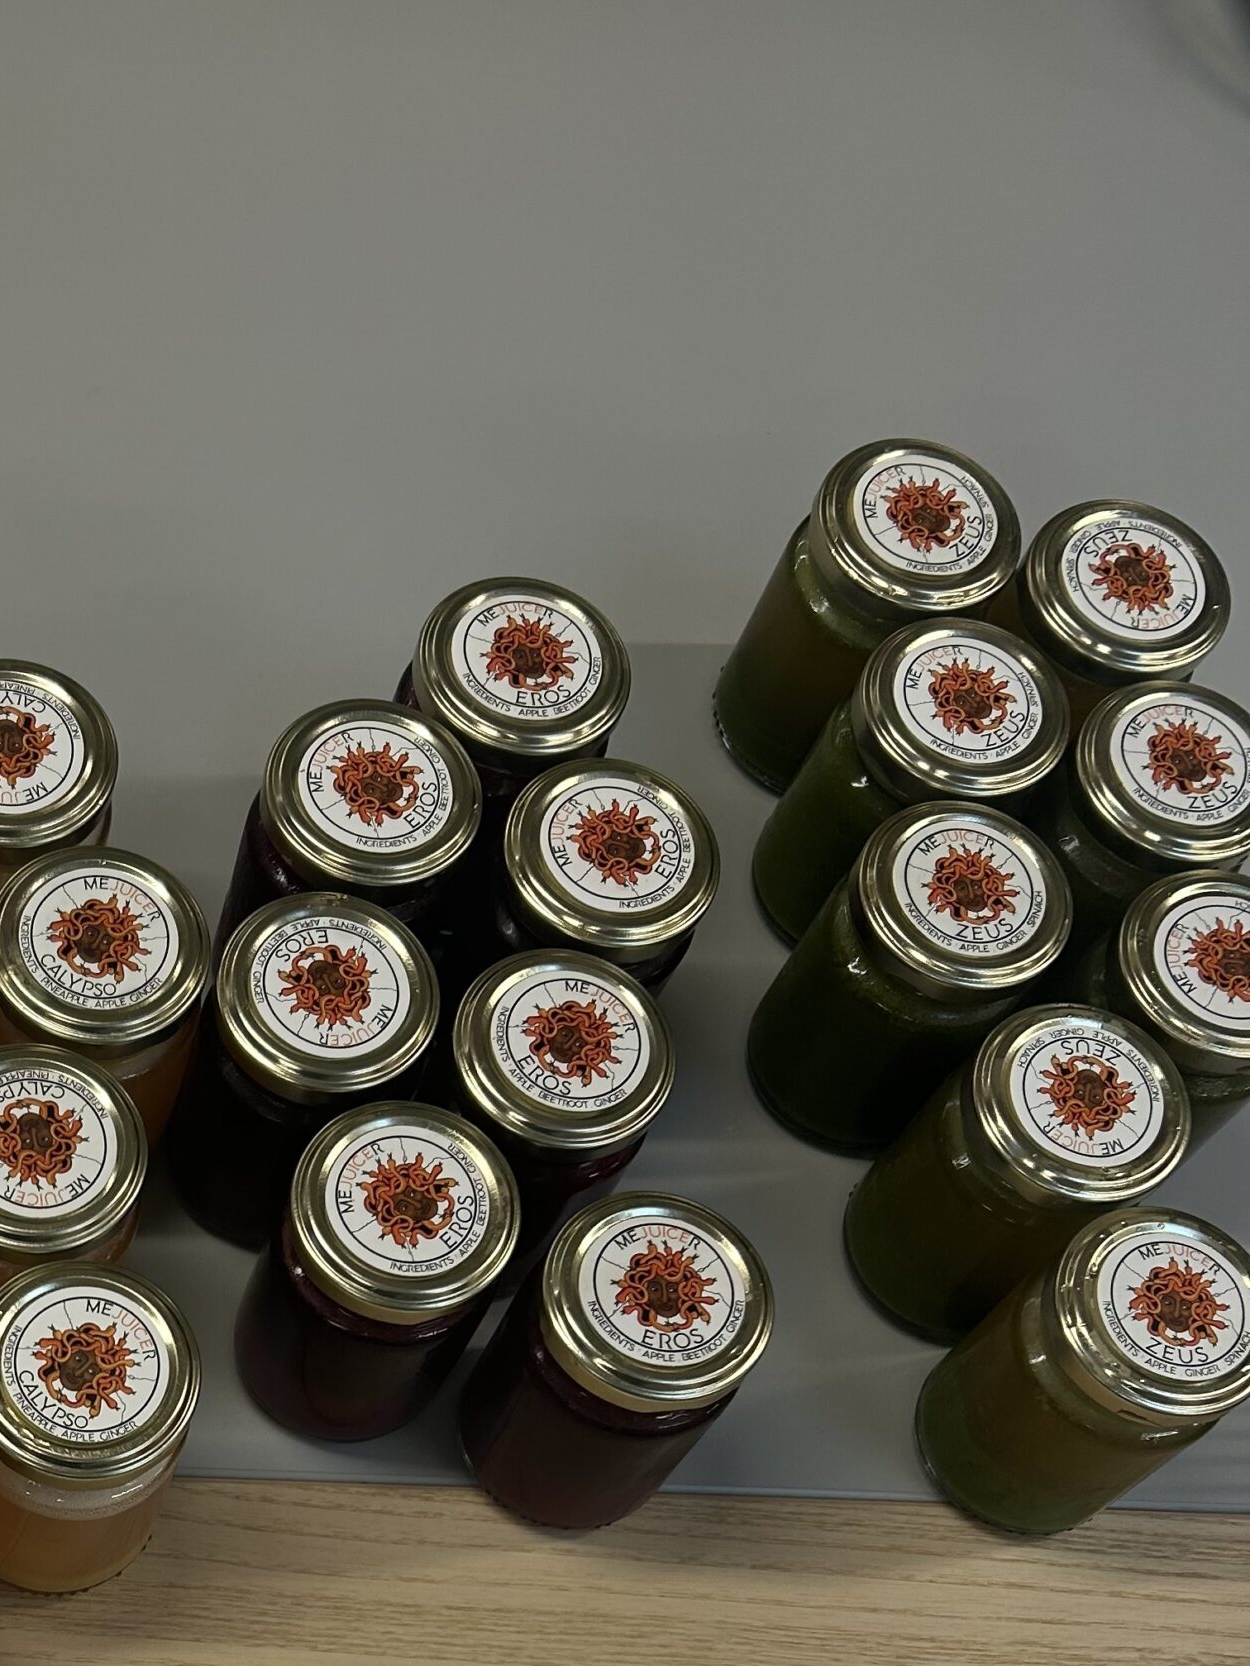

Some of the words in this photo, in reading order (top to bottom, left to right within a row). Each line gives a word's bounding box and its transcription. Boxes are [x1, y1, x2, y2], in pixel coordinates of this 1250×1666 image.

[864, 465, 906, 519] MEJUICER
[949, 515, 983, 558] ZEUS
[1084, 529, 1132, 557] ZEUS
[477, 602, 555, 628] MEJUICER
[515, 684, 572, 707] EROS
[985, 709, 1026, 748] ZEUS
[310, 731, 355, 793] MEJUICER
[403, 780, 438, 831] EROS
[1187, 780, 1238, 810] ZEUS
[656, 827, 682, 880] EROS
[919, 832, 995, 857] MEJUICER
[83, 875, 161, 922] MEJUICER
[275, 929, 330, 963] EROS
[955, 918, 1015, 942] ZEUS
[39, 953, 117, 998] CALYPSO
[1164, 922, 1198, 994] MEJUICER
[565, 980, 636, 1034] MEJUICER
[1064, 1039, 1121, 1067] ZEUS
[515, 1053, 572, 1097] EROS
[441, 1194, 475, 1251] EROS
[613, 1224, 701, 1250] MEJUICER
[1138, 1242, 1222, 1277] MEJUICER
[85, 1298, 157, 1362] MEJUICER
[587, 1300, 636, 1352] INGREDIENTS
[641, 1348, 676, 1363] APPLE
[681, 1336, 728, 1362] BEETROOT
[727, 1300, 744, 1336] GINGER
[640, 1327, 705, 1350] EROS
[1145, 1336, 1210, 1364] ZEUS
[17, 1368, 90, 1429] CALYPSO
